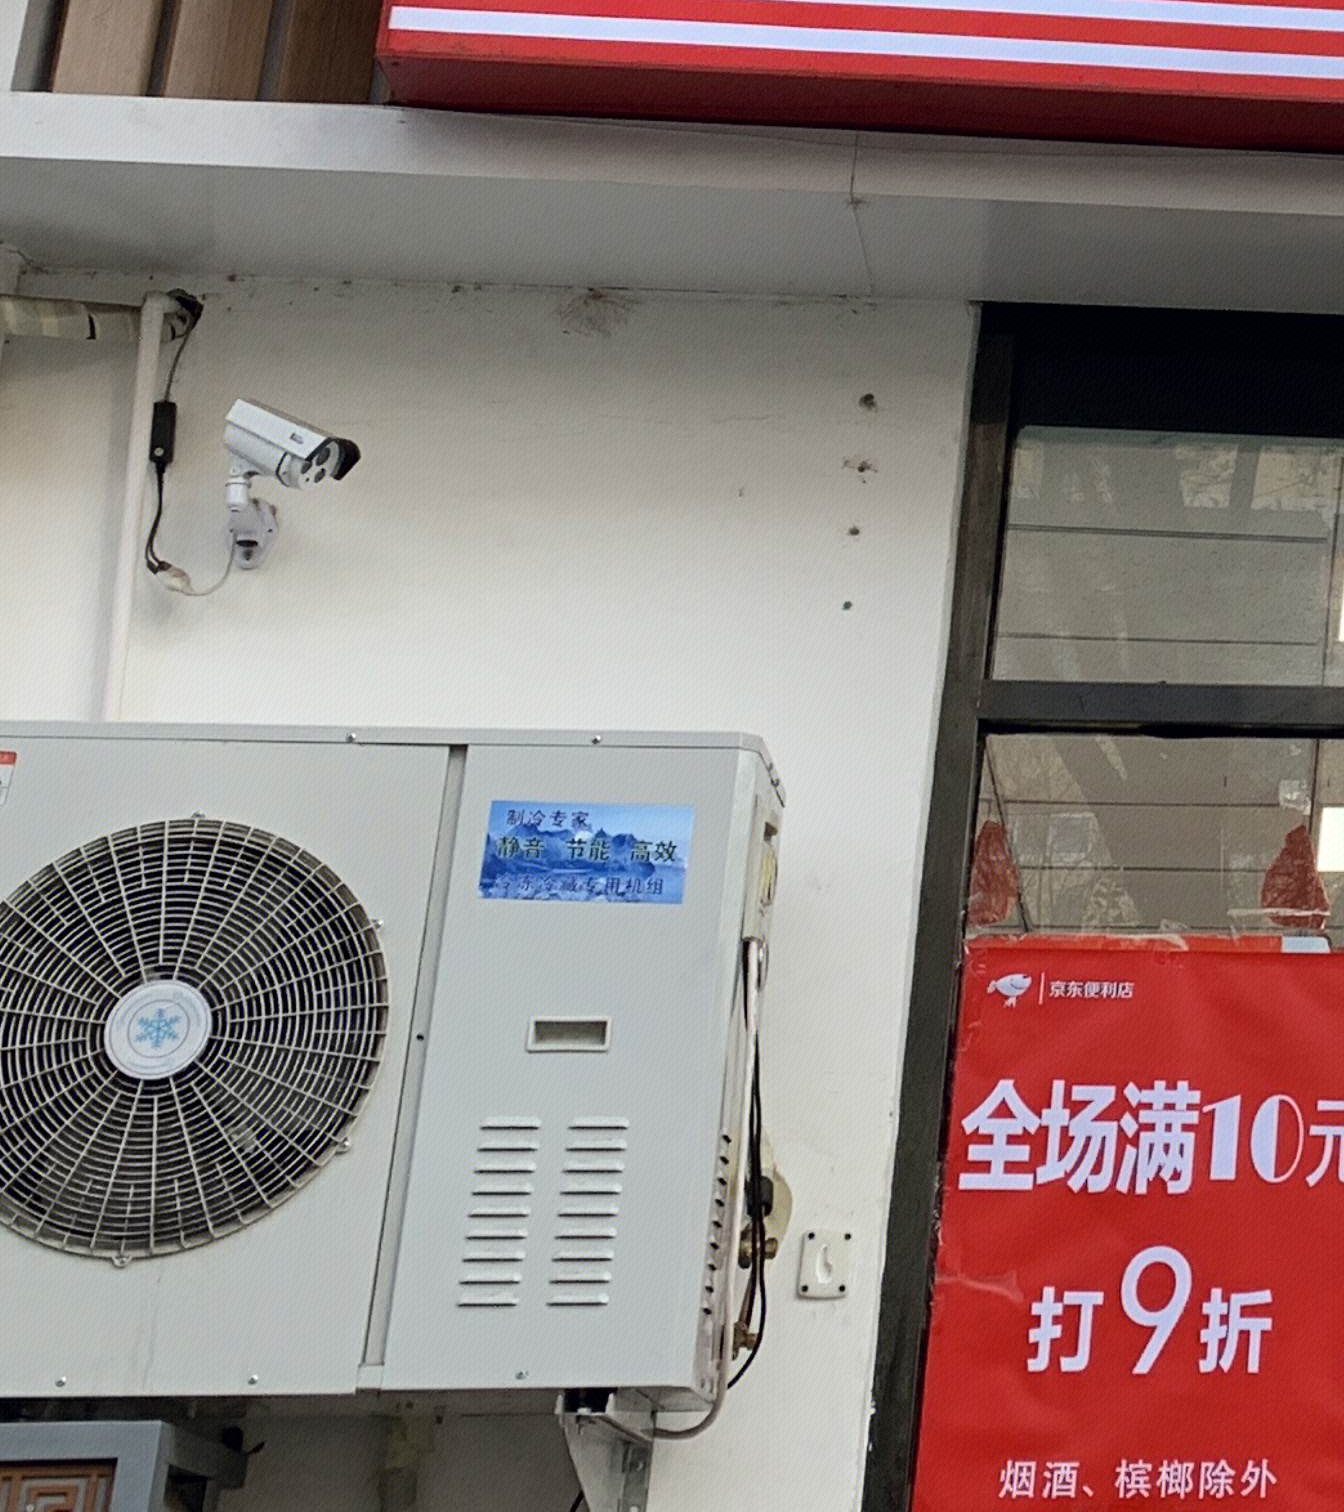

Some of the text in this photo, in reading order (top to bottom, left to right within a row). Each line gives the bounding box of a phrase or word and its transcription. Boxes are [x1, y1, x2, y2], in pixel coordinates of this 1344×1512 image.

[506, 808, 590, 829] 制冷专家
[496, 836, 678, 863] 静音 节能 高效
[1049, 980, 1135, 1000] 京东便利店
[1026, 1244, 1274, 1375] 打9折
[998, 1458, 1278, 1500] 烟酒、槟榔除外
